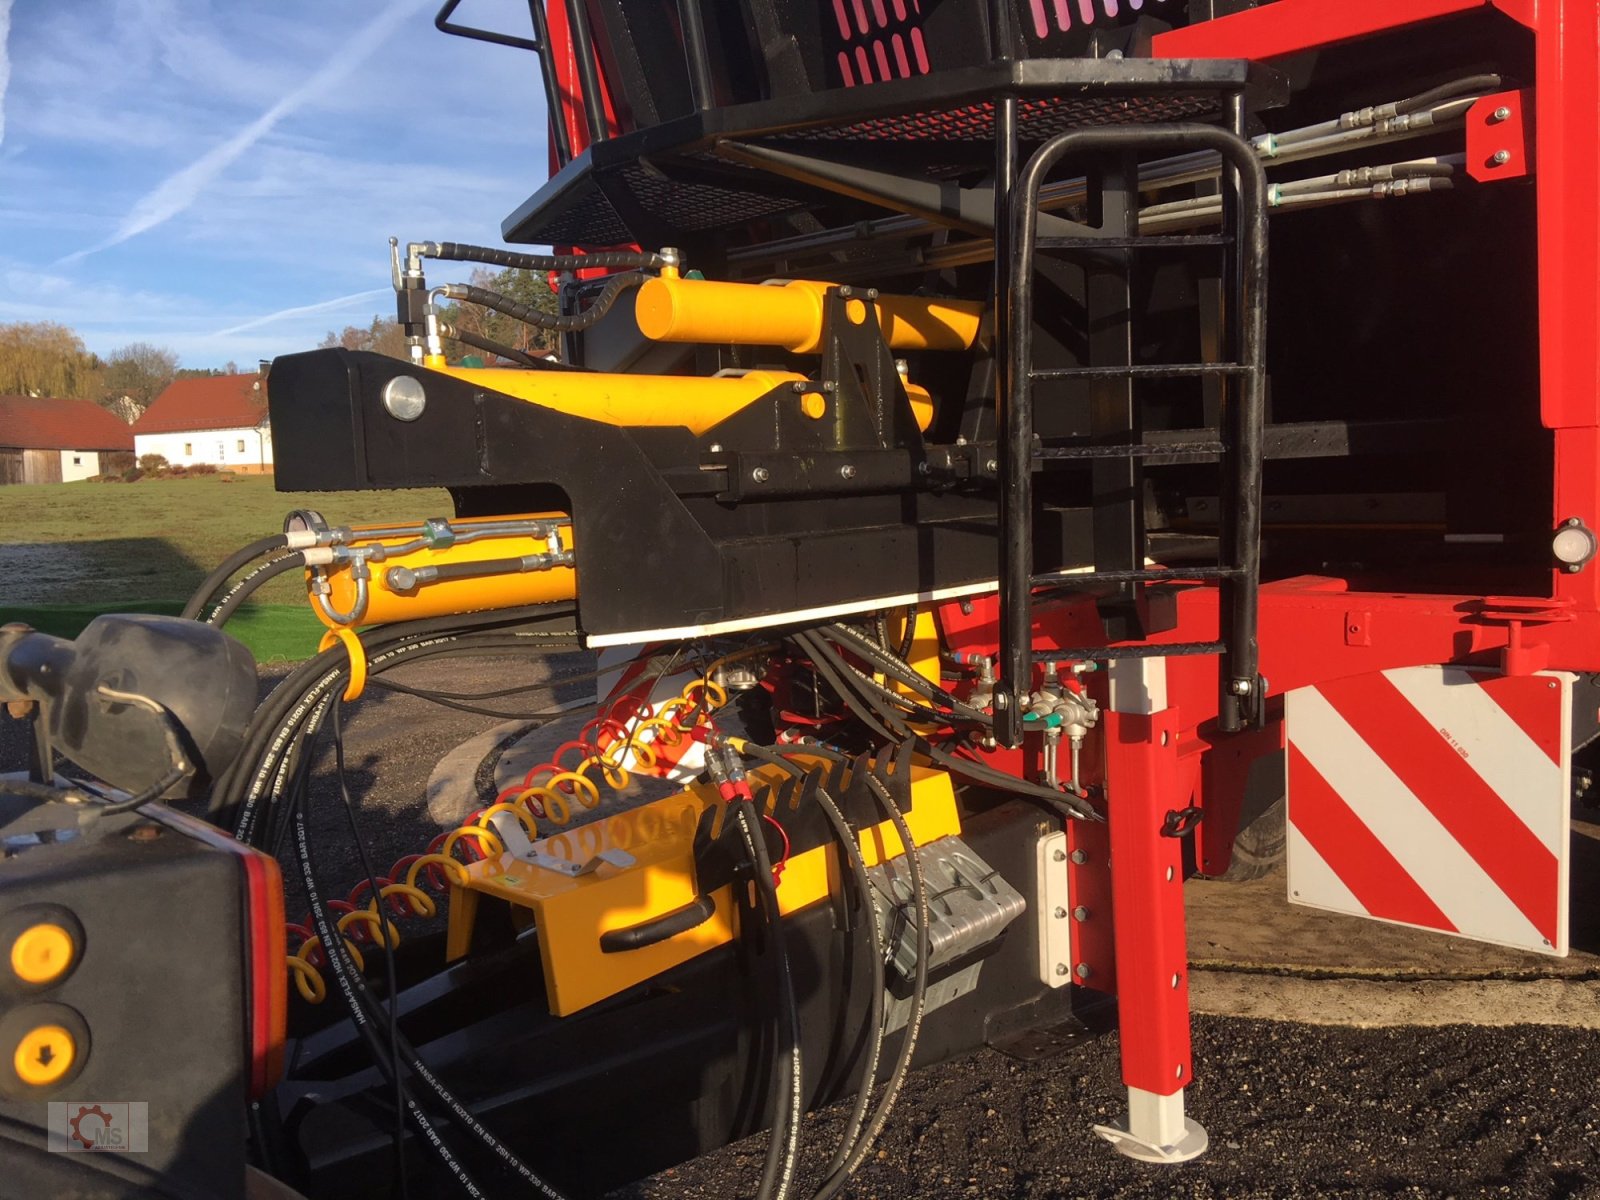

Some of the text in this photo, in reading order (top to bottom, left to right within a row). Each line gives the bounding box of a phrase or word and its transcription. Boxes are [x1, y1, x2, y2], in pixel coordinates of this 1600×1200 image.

[303, 668, 340, 704] HANSA-FLEX
[287, 704, 306, 726] HD210
[280, 726, 290, 739] EN
[1440, 728, 1452, 740] DIN
[262, 752, 275, 769] 2SN
[258, 769, 267, 778] 10
[299, 842, 308, 859] BAR
[302, 862, 312, 876] 330
[306, 876, 314, 890] WP
[310, 892, 318, 901] 10
[312, 902, 324, 918] 2SN
[318, 921, 328, 934] 853
[322, 935, 332, 946] EN
[328, 948, 343, 974] HD210
[338, 975, 367, 1025] HANSA-FLEX
[904, 1054, 911, 1066] WP
[912, 1025, 920, 1040] BAR
[792, 1110, 799, 1123] WP
[413, 1060, 557, 1199] HANSA-FLEX HD210 EN 853 2SN 10 WP 330 BAR
[426, 1128, 441, 1146] BAR
[791, 1126, 798, 1135] 10
[789, 1136, 797, 1152] 2SN
[440, 1146, 452, 1161] 330
[449, 1161, 460, 1174] WP
[783, 1168, 790, 1181] EN
[460, 1173, 469, 1184] 10
[466, 1182, 480, 1198] 2SN
[777, 1183, 787, 1200] D210
